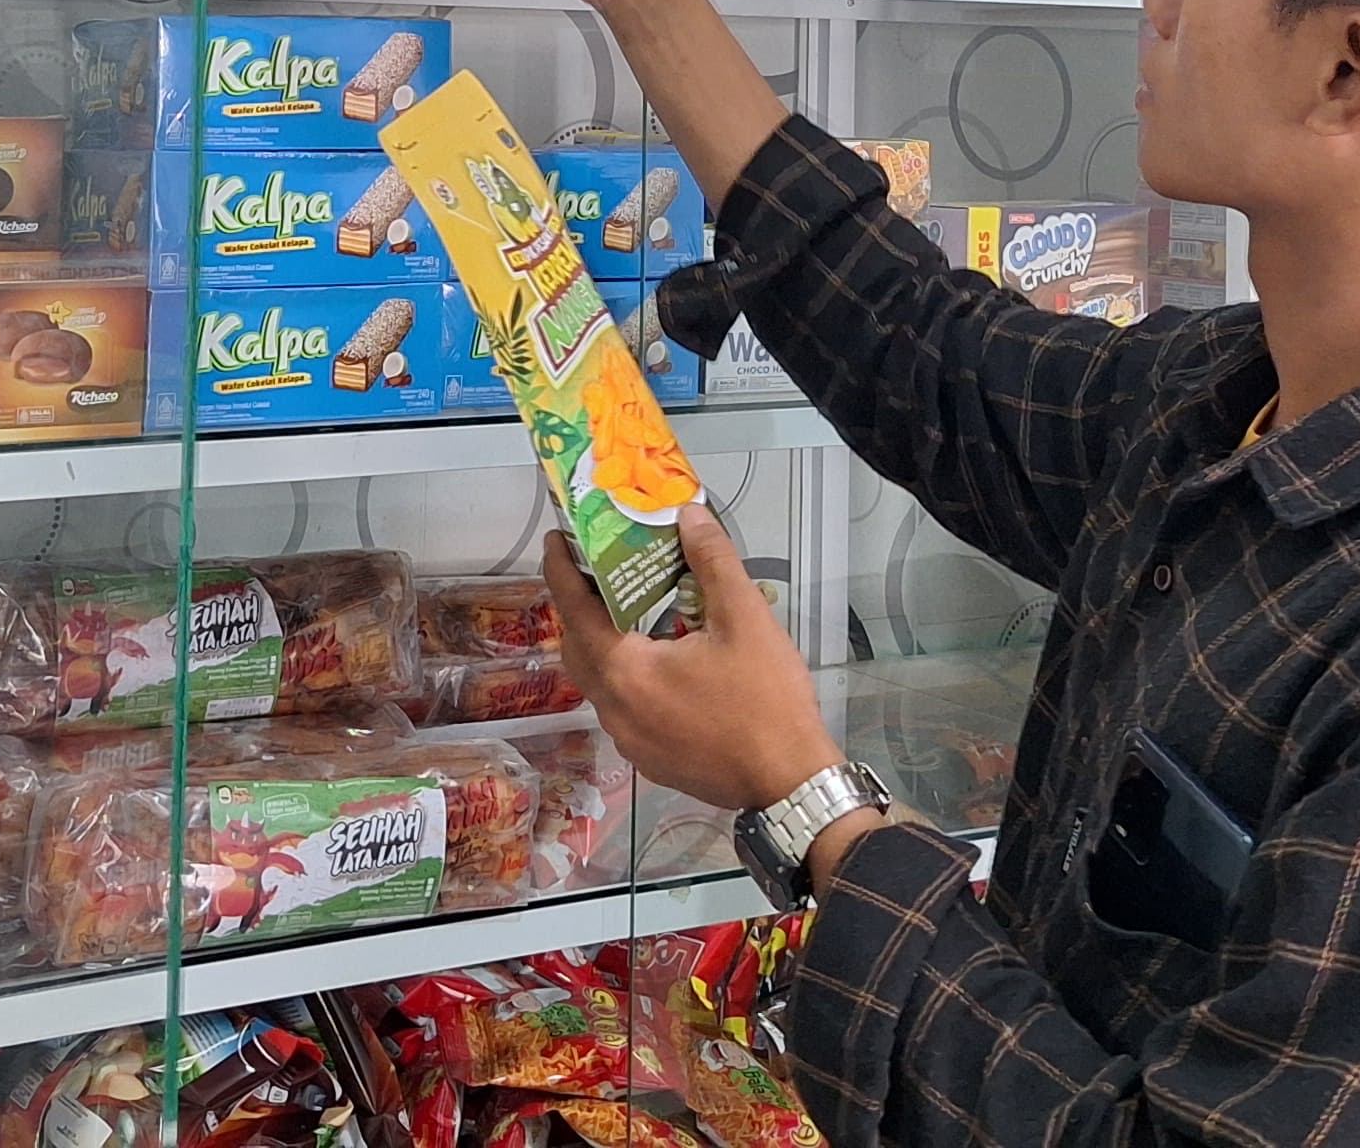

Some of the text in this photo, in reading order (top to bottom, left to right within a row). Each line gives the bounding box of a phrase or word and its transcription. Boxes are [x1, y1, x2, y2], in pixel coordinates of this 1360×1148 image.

[204, 35, 338, 102] Kalpa
[201, 171, 333, 239] Kalpa
[545, 171, 601, 220] lpa
[978, 230, 993, 269] pcs
[197, 307, 329, 375] Kalpa
[221, 375, 305, 393] Wafer Cokelat Kelapa
[737, 365, 770, 375] CHOCO
[71, 390, 119, 404] Richoco
[218, 621, 256, 651] LATA
[326, 808, 424, 855] SEUHAH
[330, 843, 417, 877] LATA LATA
